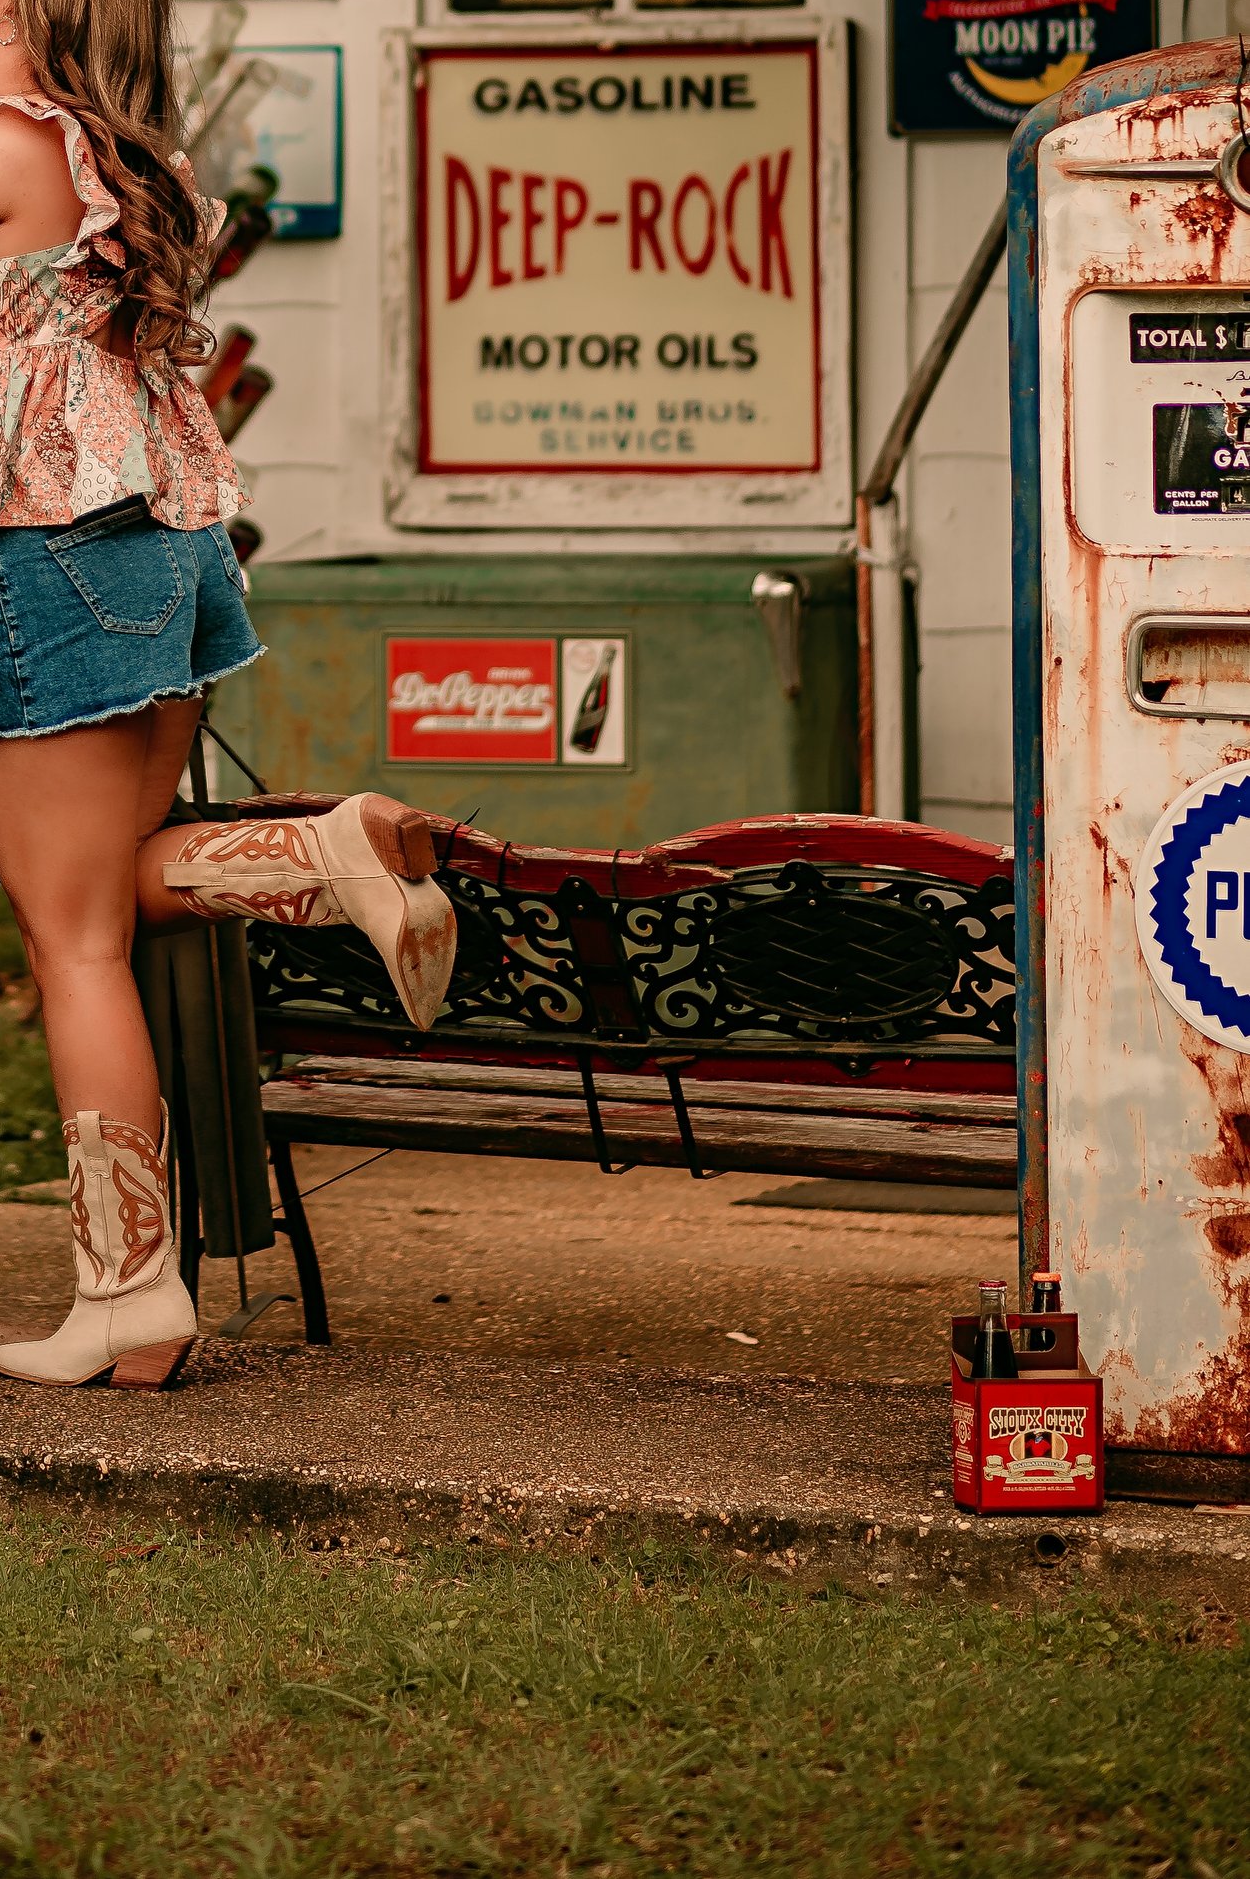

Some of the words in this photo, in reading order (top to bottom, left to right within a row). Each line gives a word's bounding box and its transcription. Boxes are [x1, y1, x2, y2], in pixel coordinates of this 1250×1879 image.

[955, 20, 1040, 55] MOON
[1047, 18, 1097, 53] PIE
[473, 74, 757, 115] GASOLINE
[444, 147, 794, 304] DEEP-ROCK
[479, 333, 640, 371] MOTOR
[656, 332, 760, 371] OILS
[1136, 329, 1207, 348] TOTAL
[1215, 324, 1228, 350] $
[539, 428, 697, 455] SERVICE
[1164, 490, 1196, 499] CENTS
[1200, 490, 1219, 499] PER
[1172, 500, 1209, 508] GALLON
[989, 1407, 1042, 1439] SIOUX
[1044, 1407, 1086, 1437] CITY
